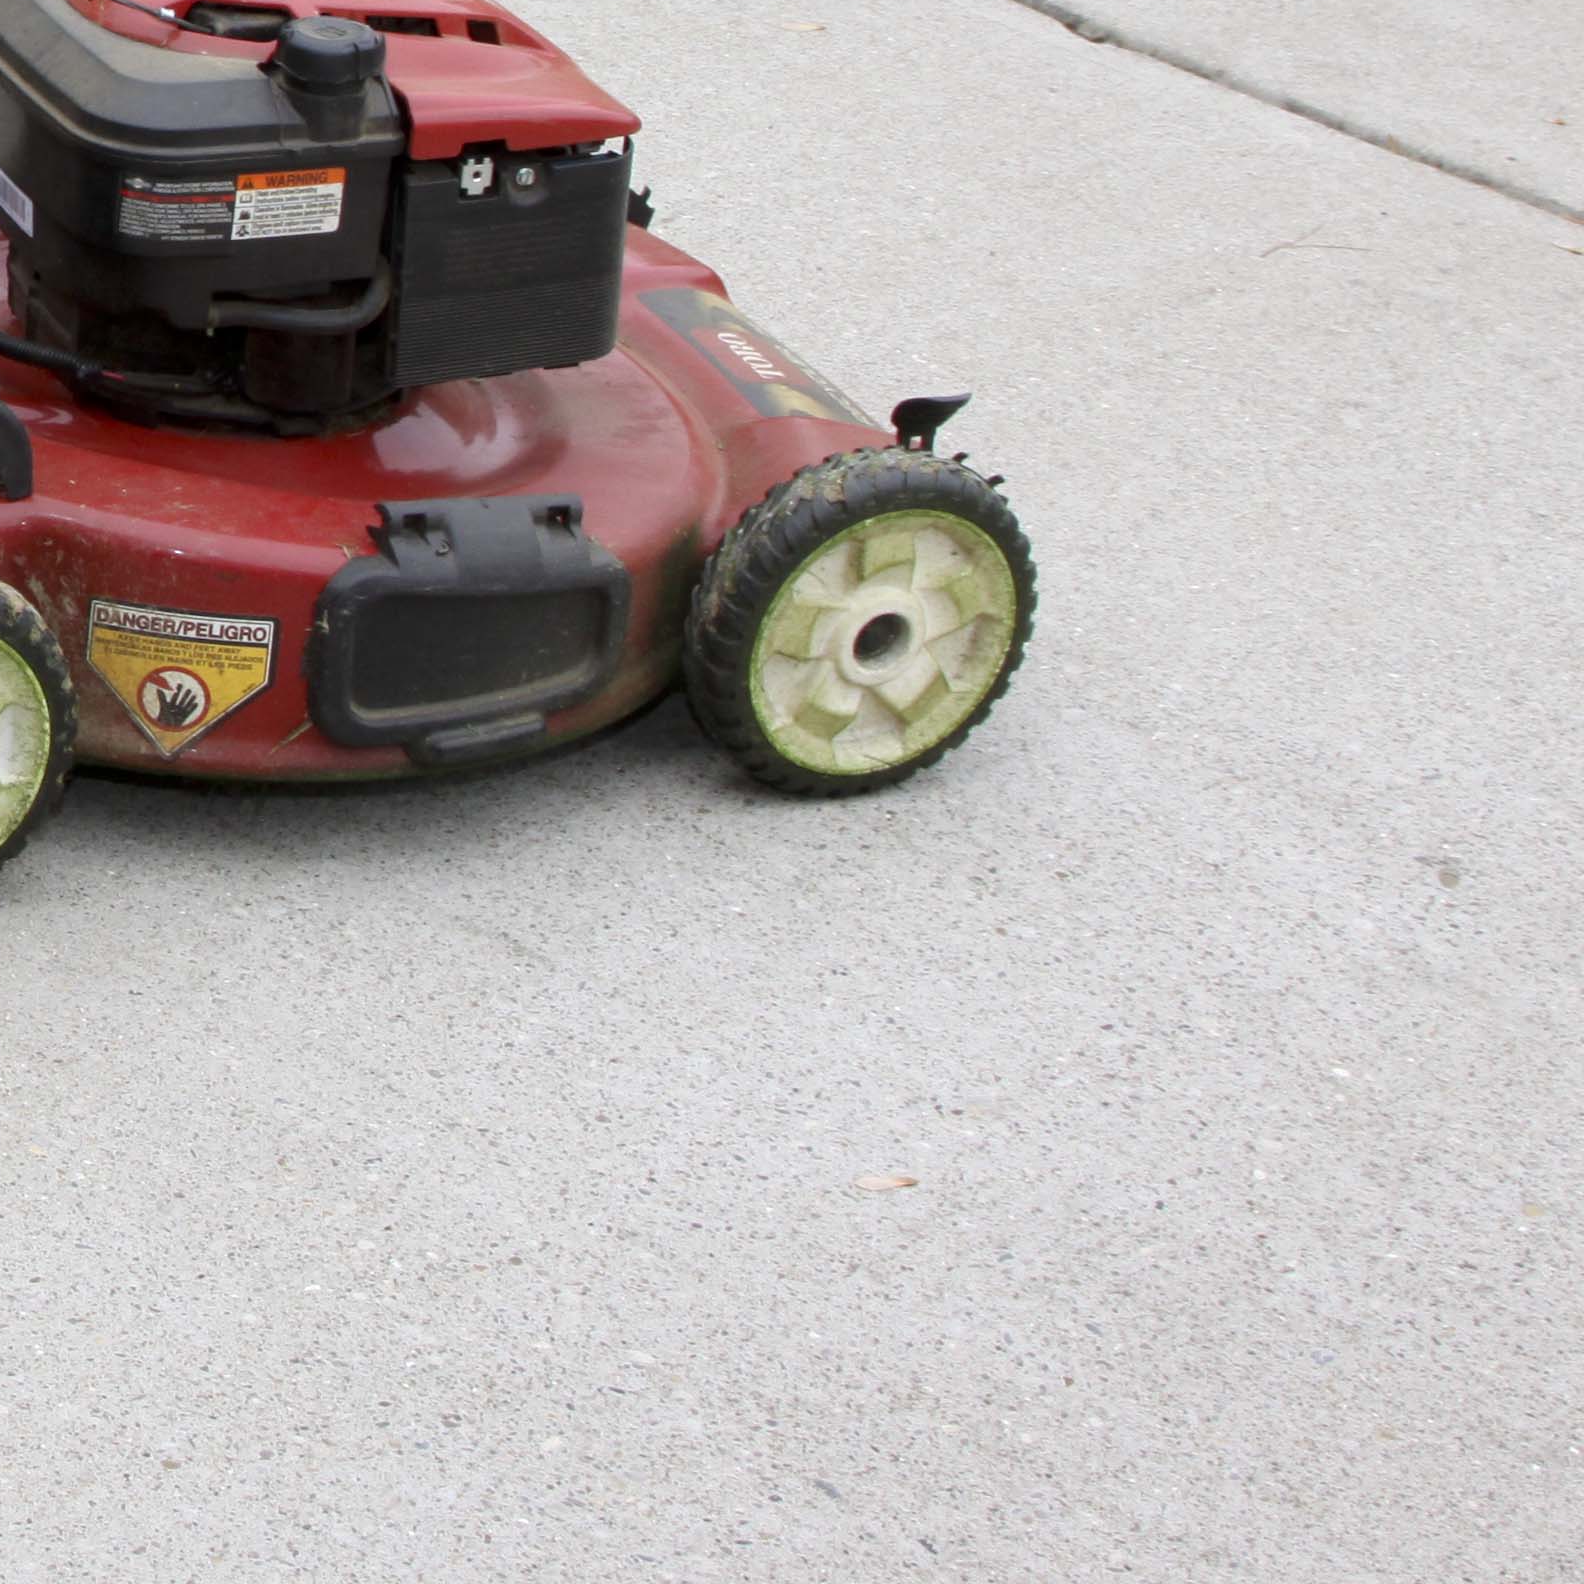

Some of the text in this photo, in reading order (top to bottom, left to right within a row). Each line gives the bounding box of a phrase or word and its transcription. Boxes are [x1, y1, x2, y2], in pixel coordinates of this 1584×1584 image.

[265, 171, 328, 187] WARNING
[717, 332, 785, 379] TORO
[96, 607, 267, 642] DANGER/PELIGRO
